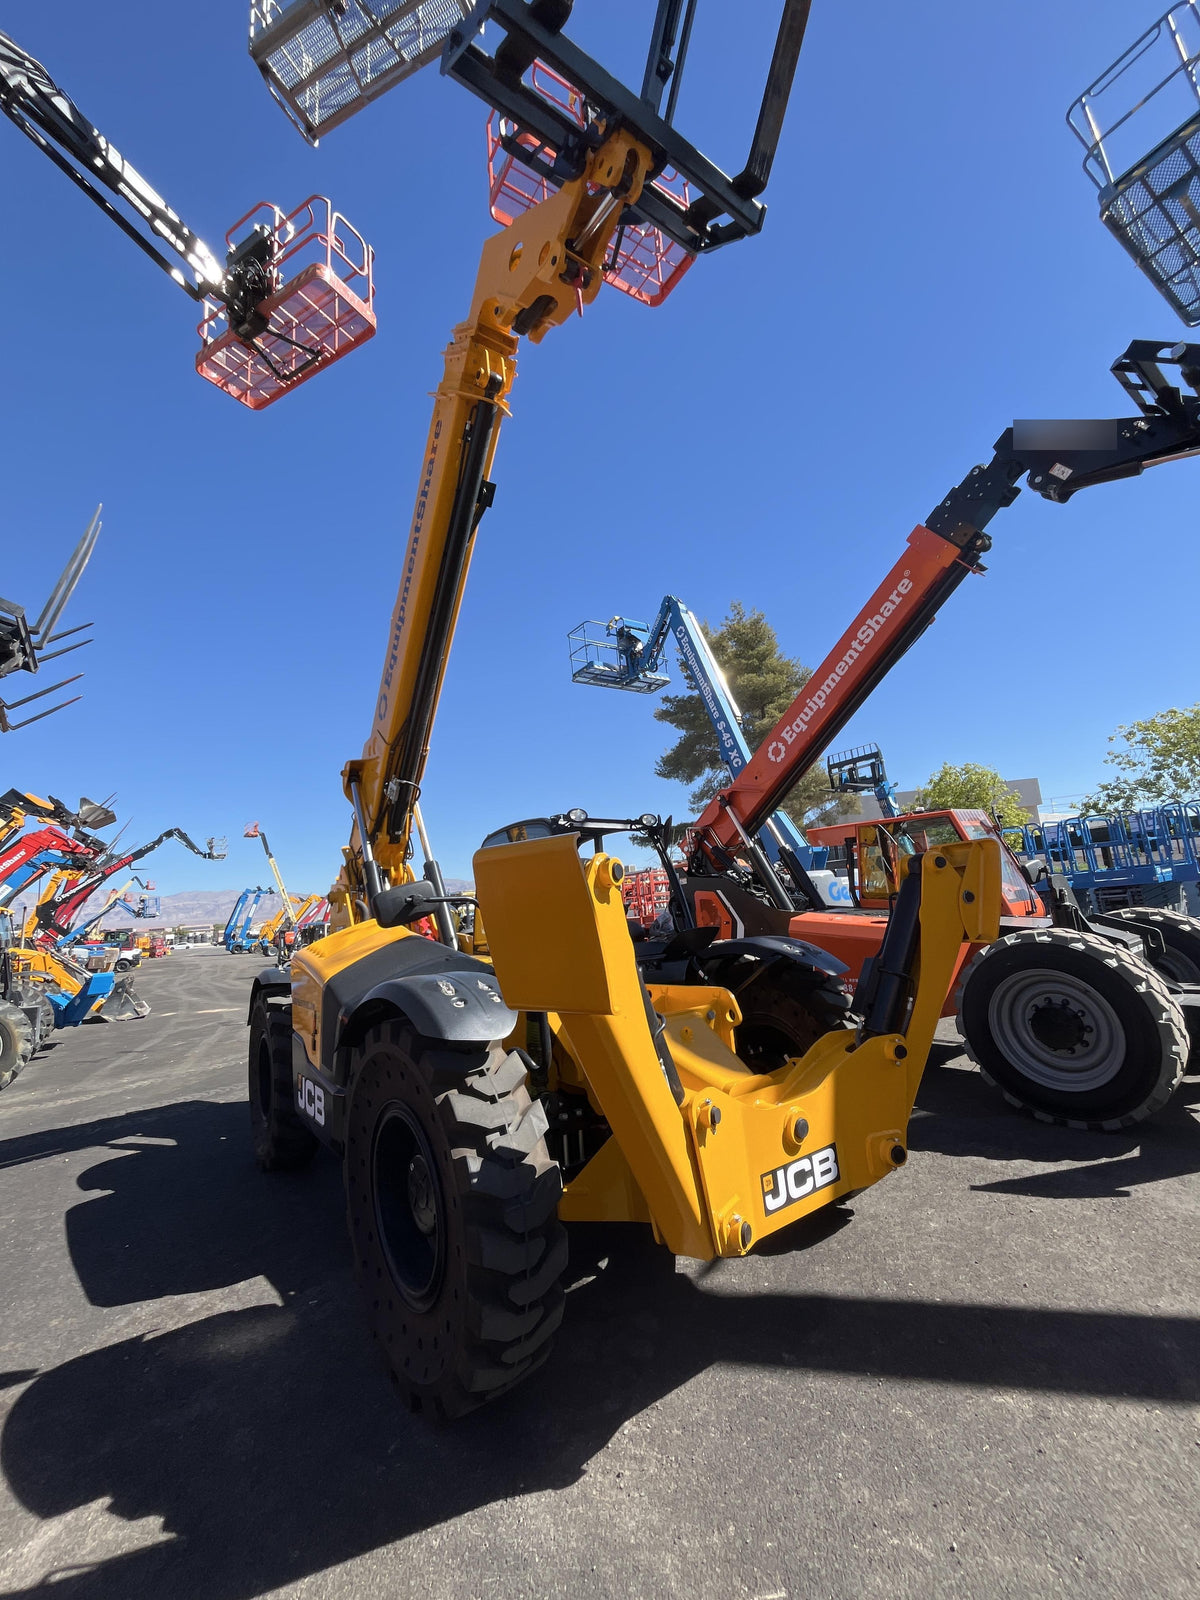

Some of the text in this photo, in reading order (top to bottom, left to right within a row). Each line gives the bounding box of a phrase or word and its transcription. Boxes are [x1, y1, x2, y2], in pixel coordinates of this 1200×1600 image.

[383, 419, 442, 689] EquipmentShare
[680, 637, 742, 768] EquipmentShare S-45 XC
[104, 855, 134, 876] MANITOU
[828, 881, 859, 901] Ge
[297, 1075, 325, 1127] JCB
[765, 1147, 838, 1211] JCB
